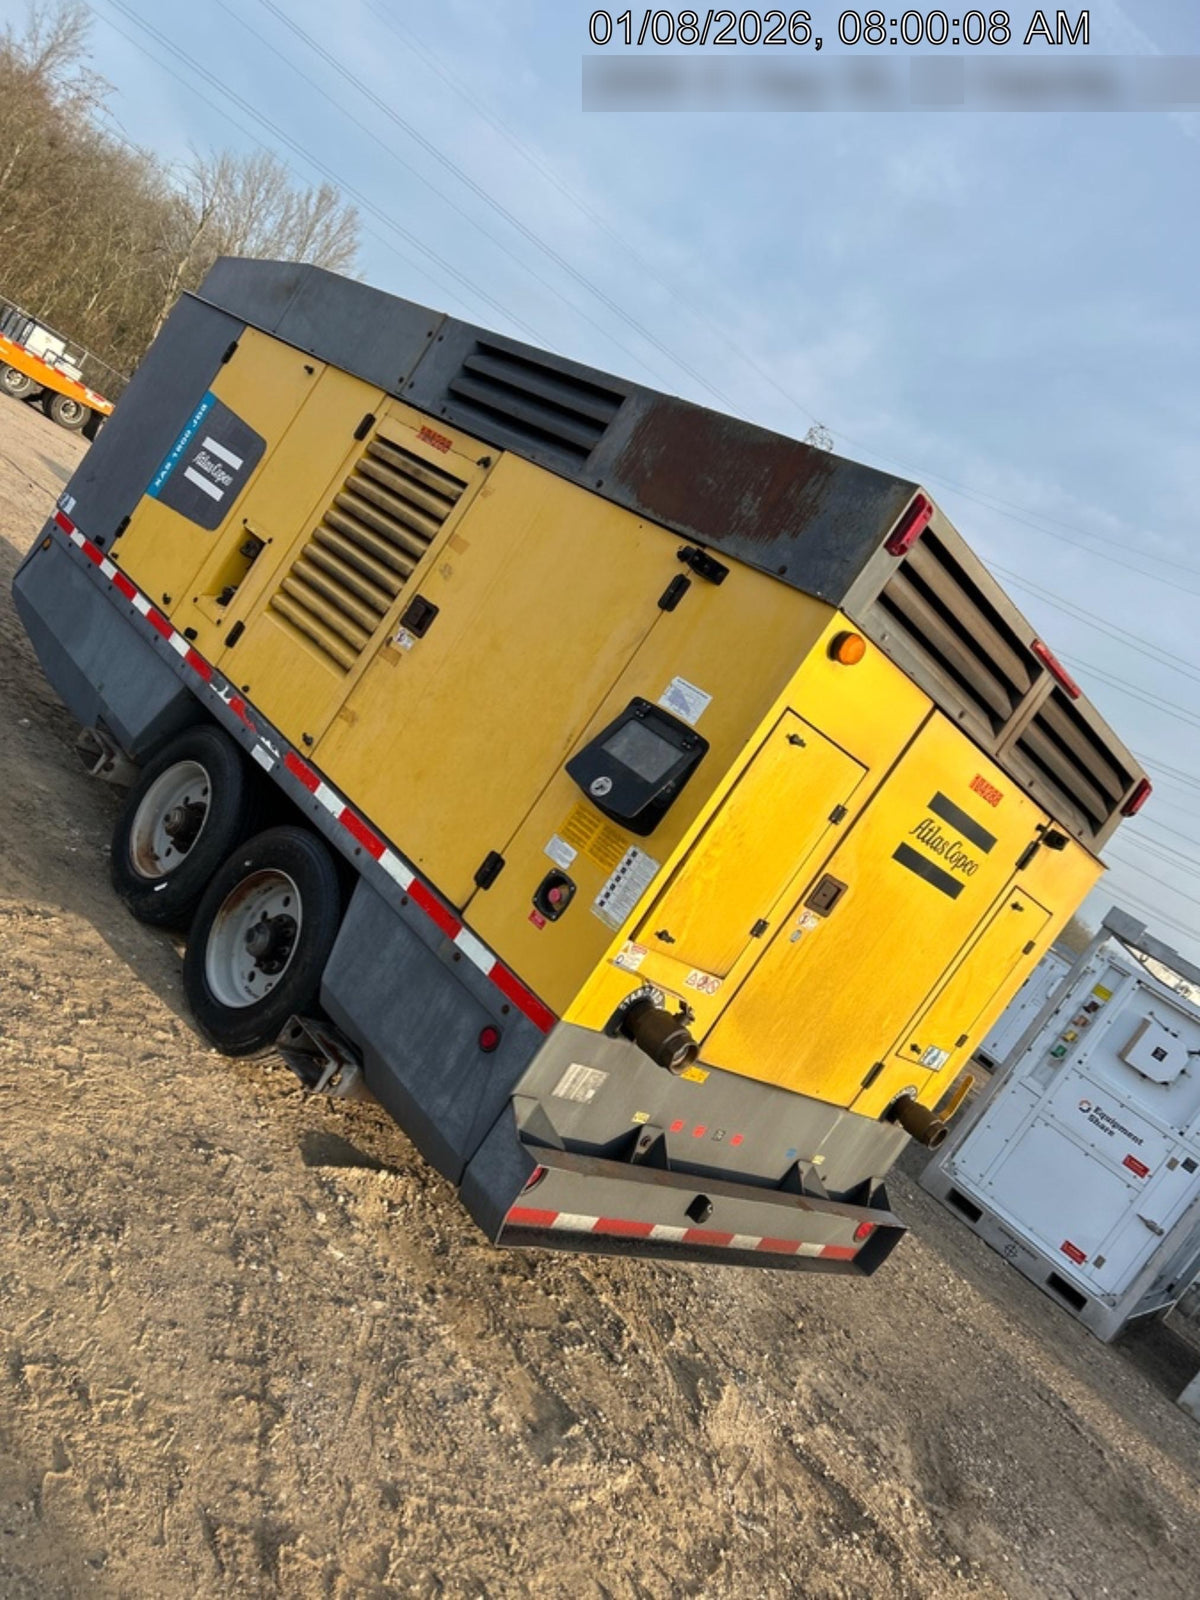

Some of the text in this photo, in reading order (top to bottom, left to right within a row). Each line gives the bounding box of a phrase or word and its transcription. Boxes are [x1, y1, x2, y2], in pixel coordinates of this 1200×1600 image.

[908, 818, 979, 876] Atlas Copco
[1088, 1114, 1115, 1137] Share
[1093, 1106, 1144, 1145] Equipment
